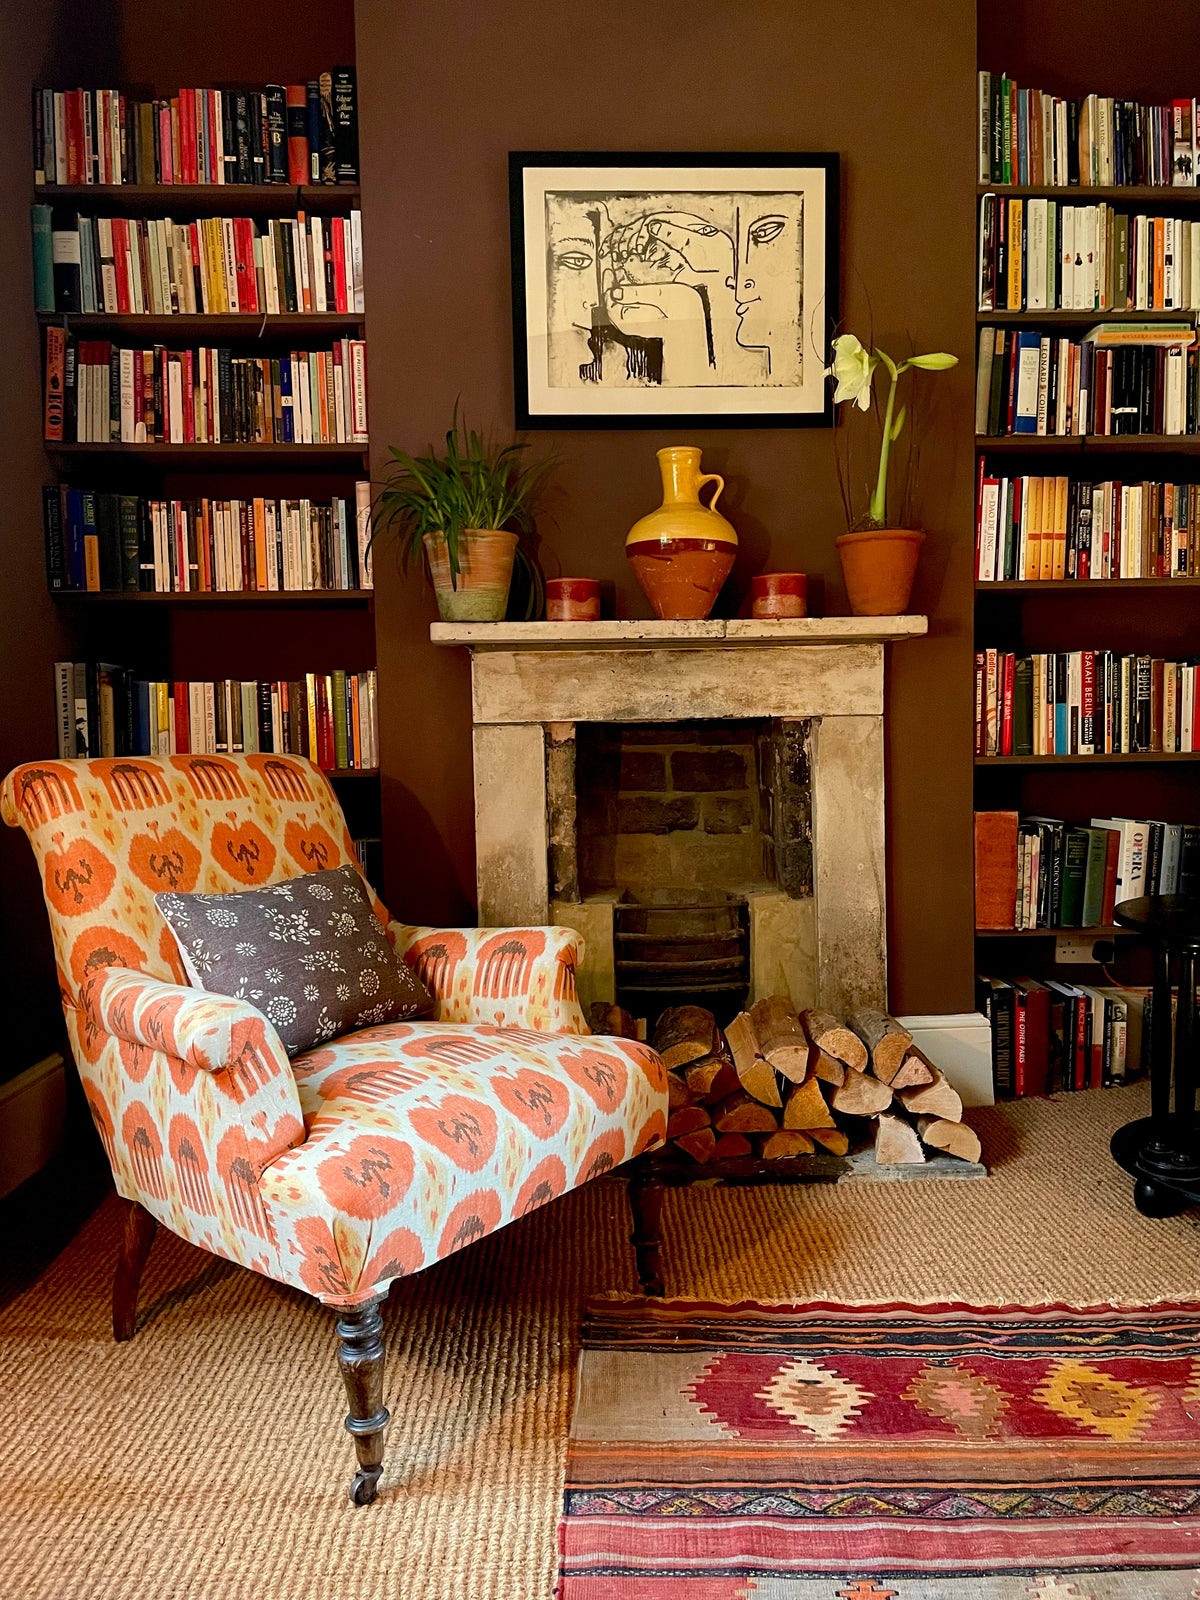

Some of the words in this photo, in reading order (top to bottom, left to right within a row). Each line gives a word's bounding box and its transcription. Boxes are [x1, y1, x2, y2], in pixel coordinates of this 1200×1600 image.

[337, 104, 353, 112] Allan
[273, 132, 281, 143] B
[48, 394, 62, 426] ECO
[988, 520, 995, 531] DE
[987, 532, 995, 551] JING
[1085, 652, 1093, 683] ISAIAH
[1085, 687, 1093, 718] BERLIN
[1131, 832, 1144, 880] OPERA
[996, 1010, 1010, 1046] ARCADES
[996, 1049, 1010, 1088] PROJECT
